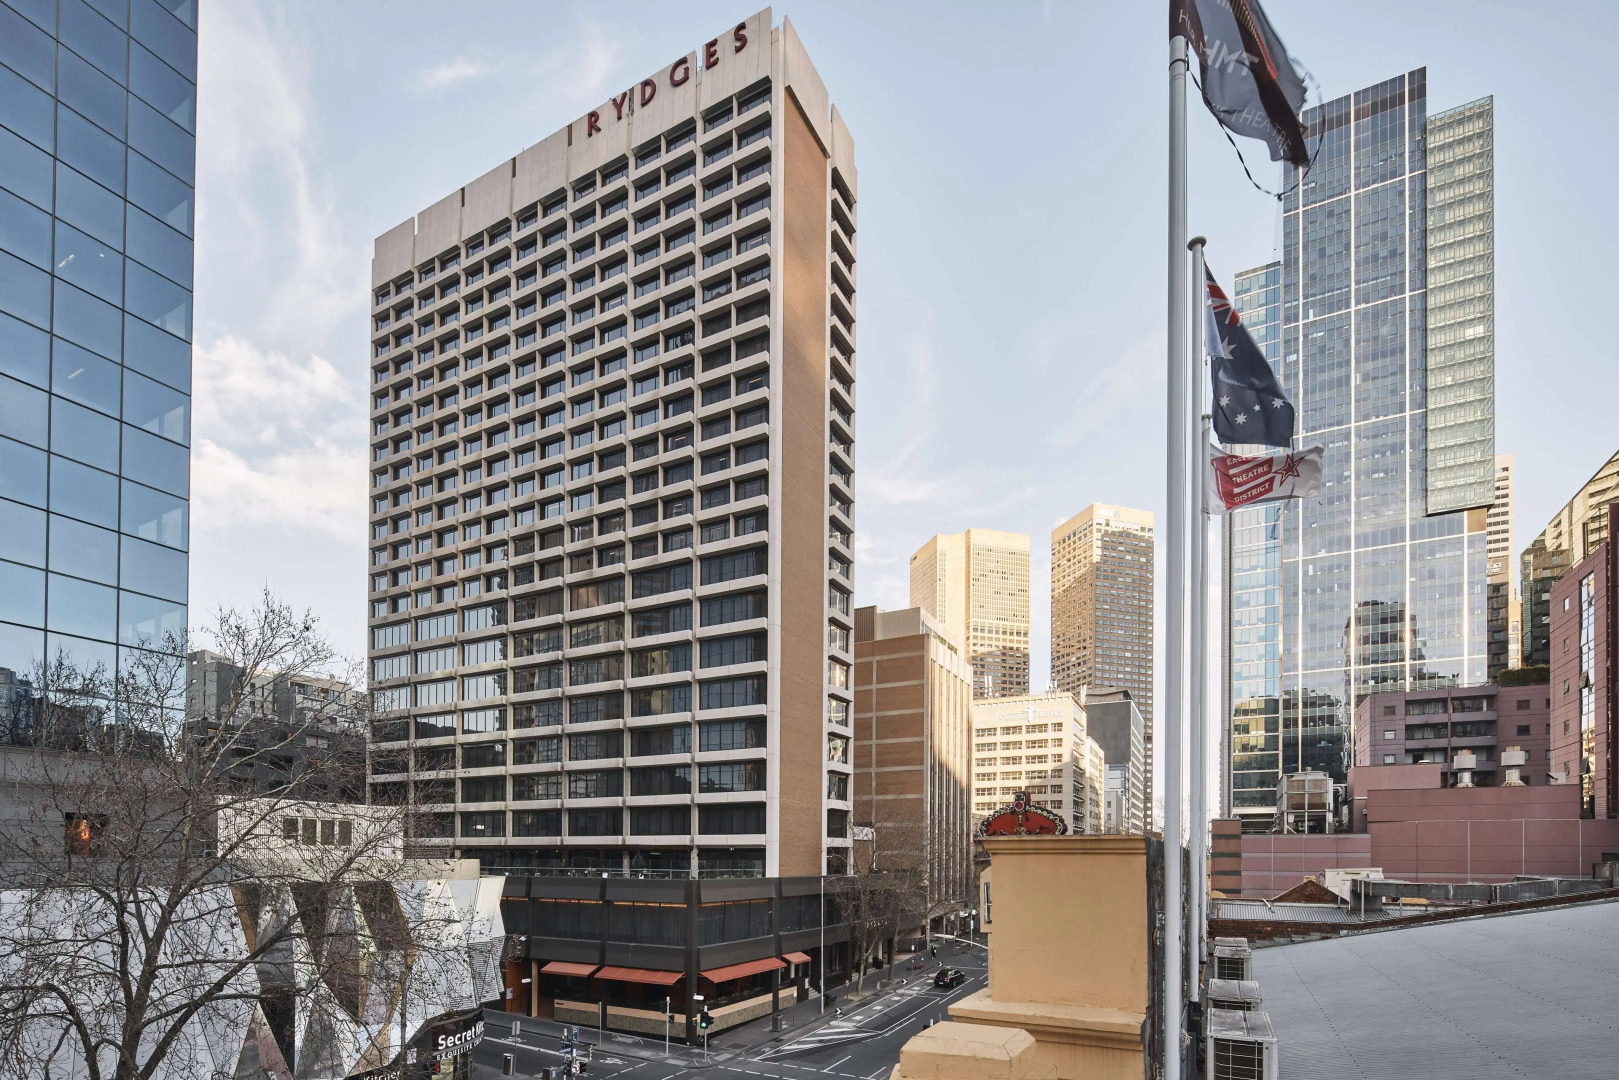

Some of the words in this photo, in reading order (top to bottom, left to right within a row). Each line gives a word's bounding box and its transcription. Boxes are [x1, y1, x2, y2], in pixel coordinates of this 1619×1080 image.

[587, 21, 748, 138] RYDGES
[1232, 464, 1269, 484] THEATRE
[1234, 482, 1270, 502] DISTRICT
[438, 1025, 475, 1050] Secret
